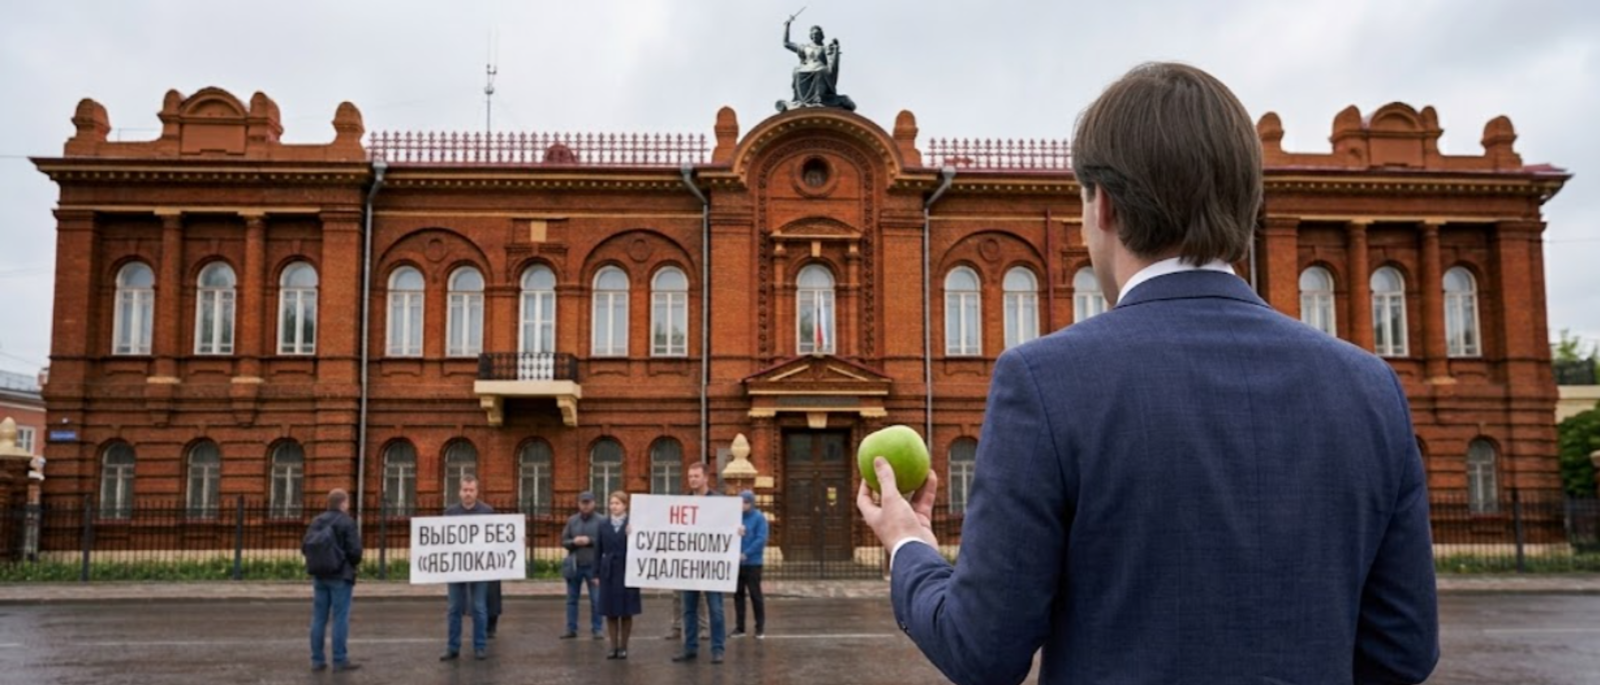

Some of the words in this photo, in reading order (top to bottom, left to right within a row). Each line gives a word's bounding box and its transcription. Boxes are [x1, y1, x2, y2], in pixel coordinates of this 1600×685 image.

[669, 505, 699, 525] НЕТ
[419, 524, 479, 546] ВЫБОР
[485, 523, 516, 544] БЕЗ
[636, 531, 733, 553] СУДЕБНОМУ
[418, 549, 517, 573] «ЯБЛОКА»?
[637, 557, 731, 581] УДАЛЕНИЮ!
